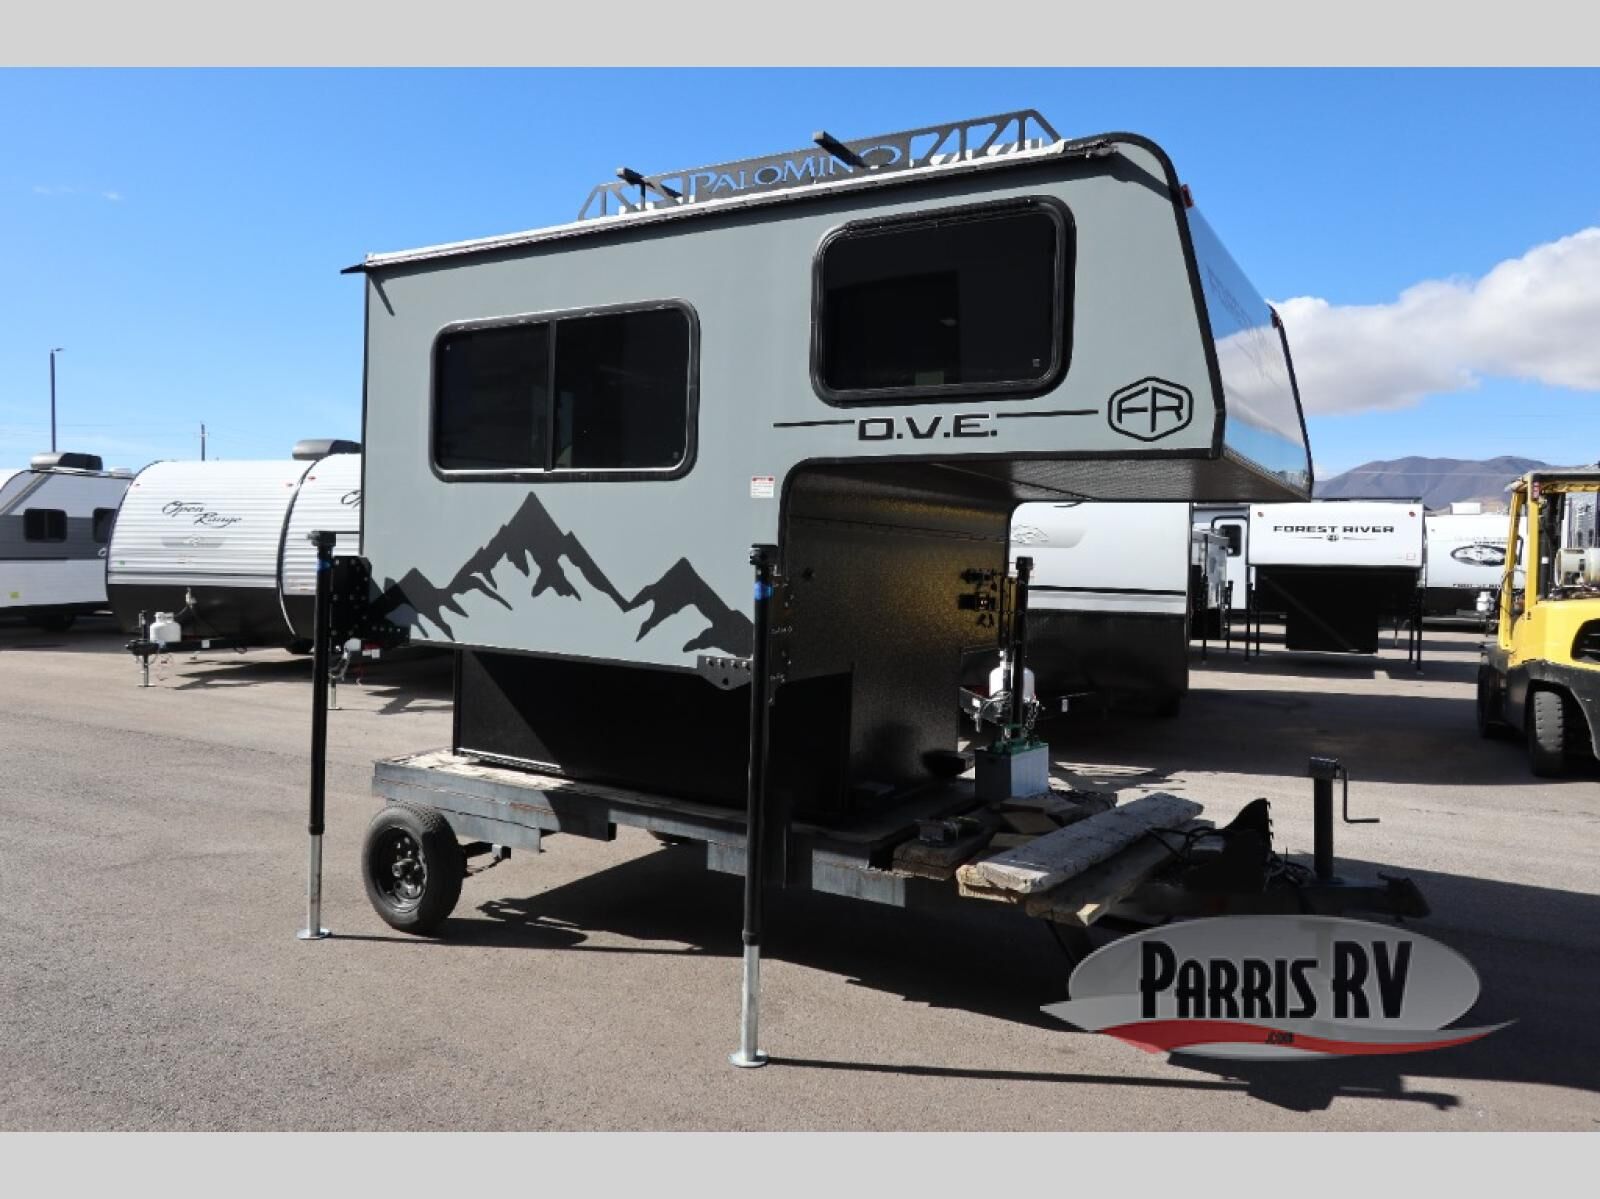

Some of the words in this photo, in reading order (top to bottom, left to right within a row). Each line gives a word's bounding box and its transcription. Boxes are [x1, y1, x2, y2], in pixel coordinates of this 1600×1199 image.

[688, 144, 901, 203] PALOMINO
[857, 414, 998, 441] O.V.E.
[162, 500, 207, 517] Open
[193, 512, 243, 529] Range
[1272, 525, 1338, 533] FOREST
[1342, 525, 1395, 533] RIVER
